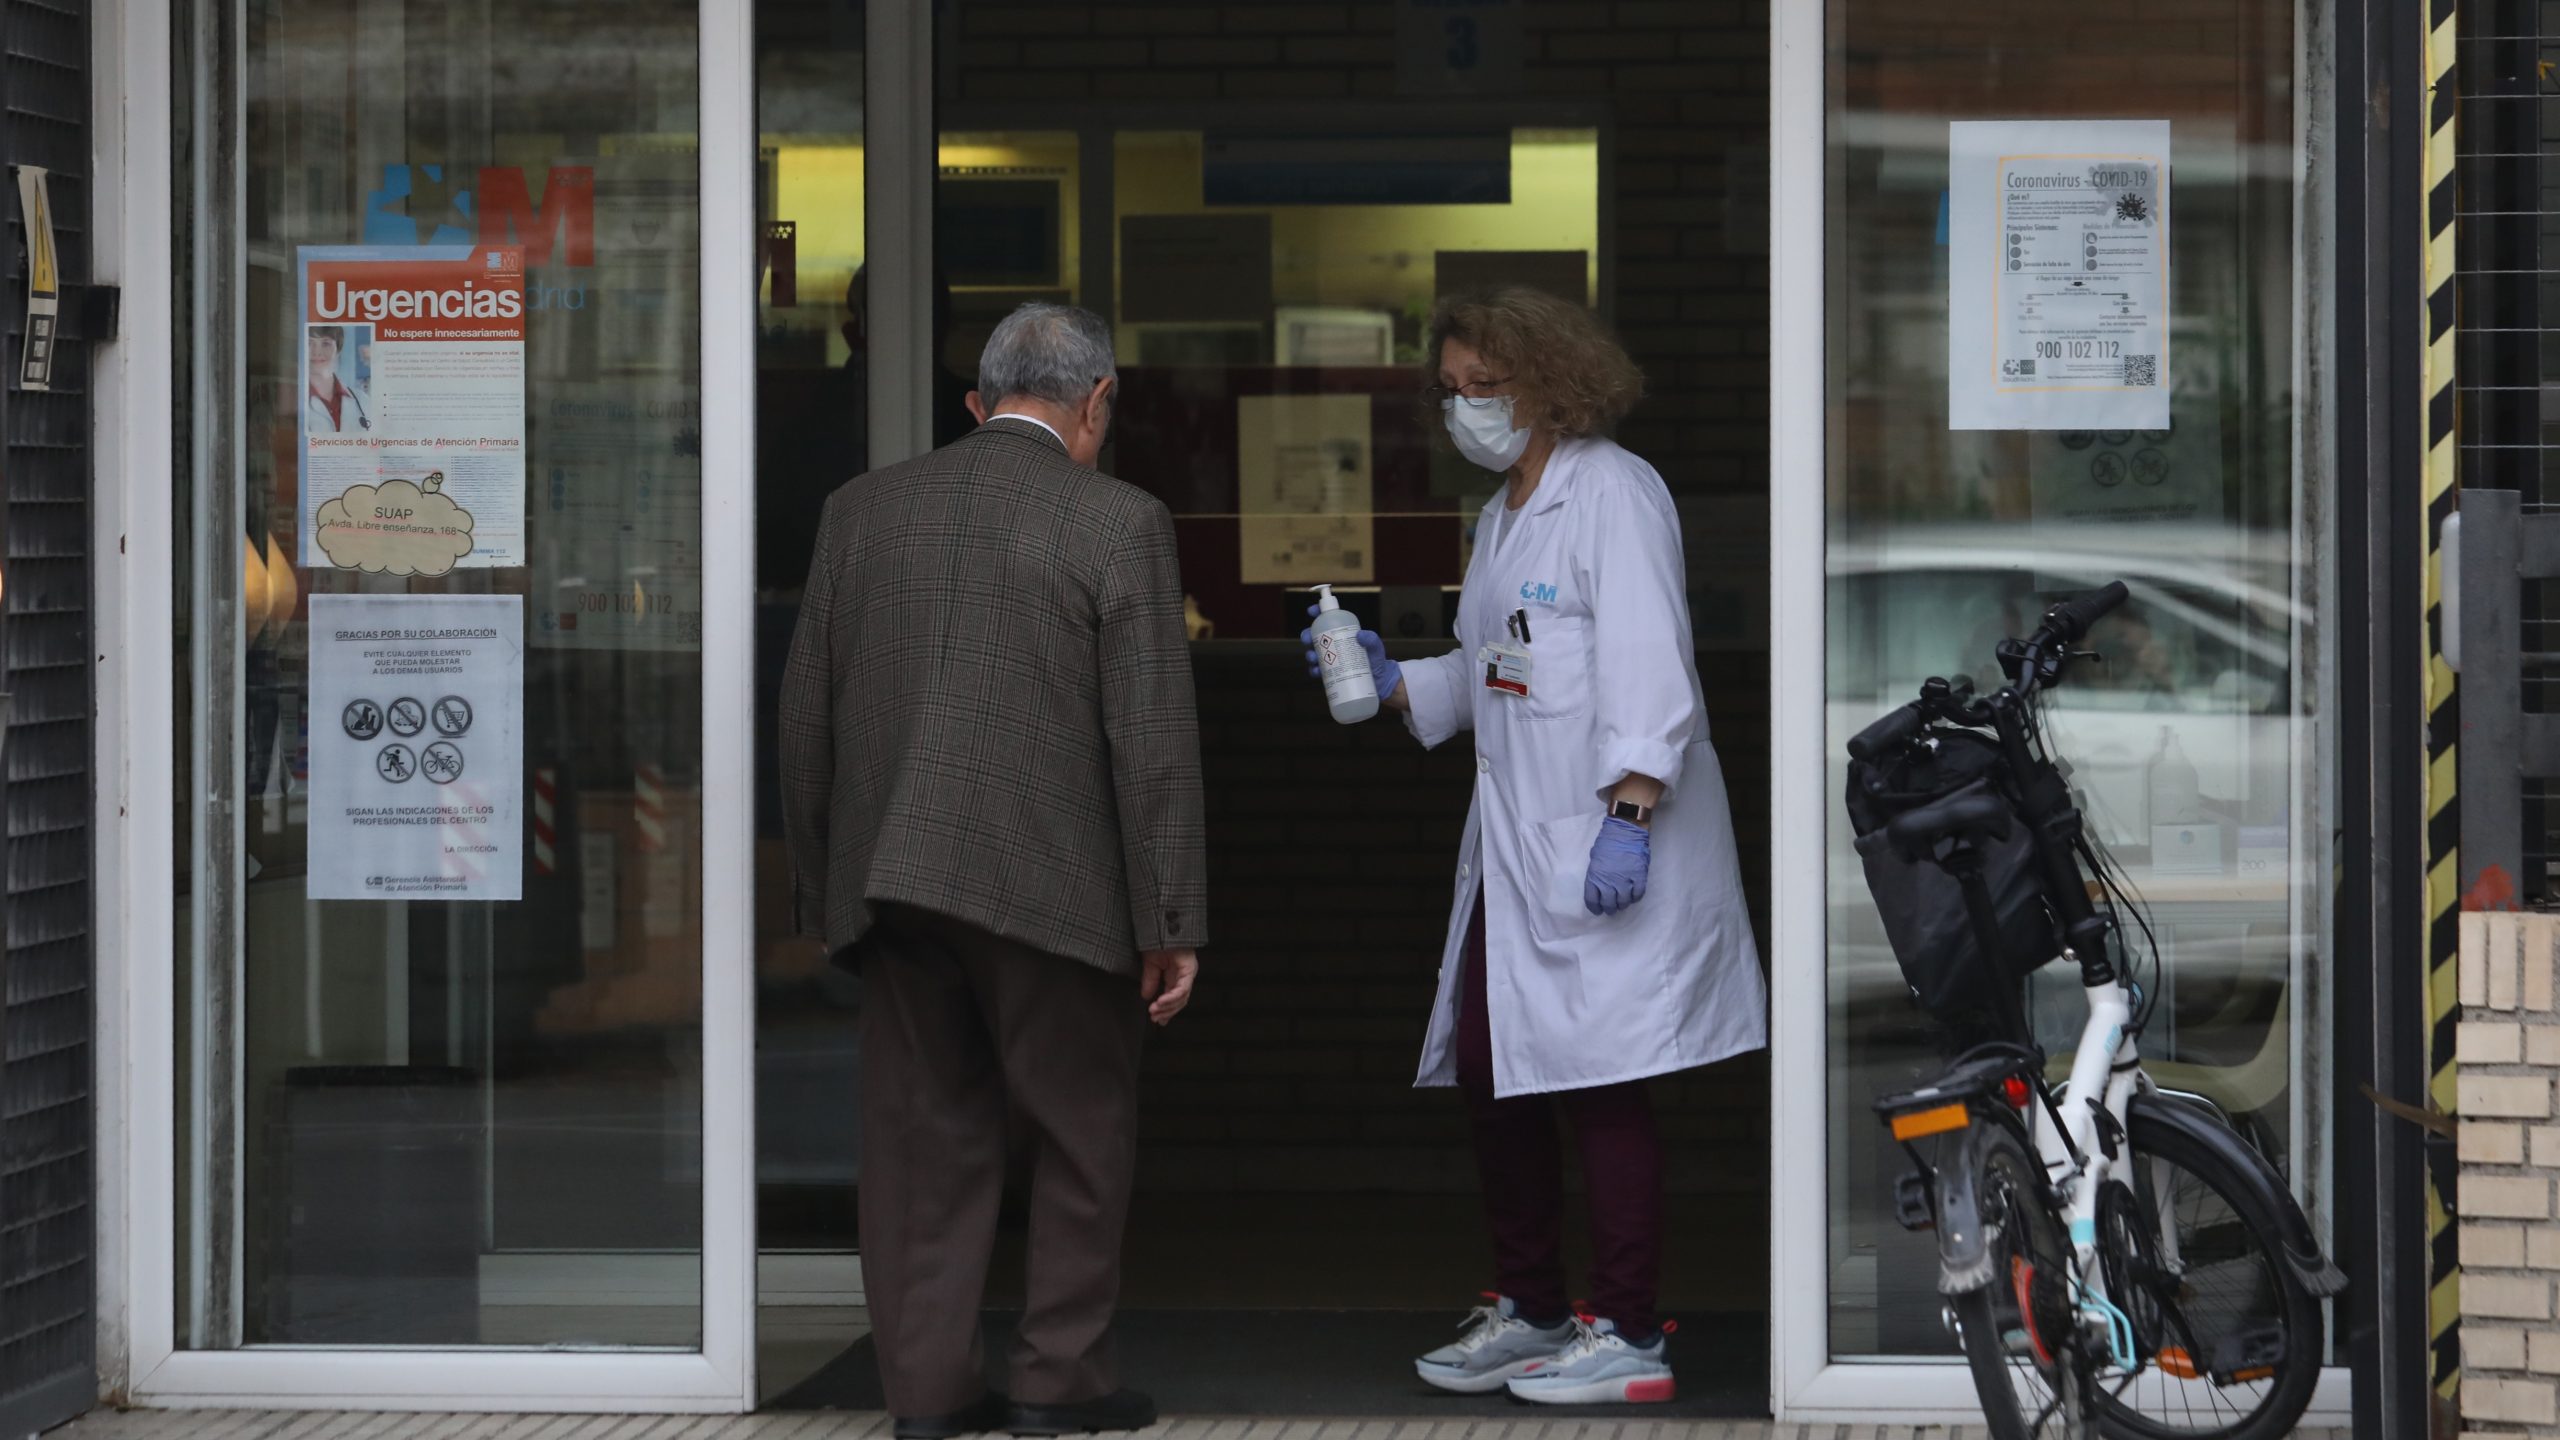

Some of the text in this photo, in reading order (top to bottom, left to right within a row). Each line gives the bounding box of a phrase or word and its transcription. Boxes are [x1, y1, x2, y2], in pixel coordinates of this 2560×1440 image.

[2007, 172, 2080, 188] Coronavirus
[2092, 171, 2148, 187] COVID-19
[315, 280, 522, 321] Urgencias
[384, 328, 520, 340] No espere innecesariamente
[2036, 341, 2120, 358] 900 102 112
[647, 400, 700, 418] COVID-1
[310, 437, 519, 448] Servicios de Urgencias de Atención Primaria
[374, 506, 413, 520] SUAP
[328, 519, 457, 536] Avda. Libre enseñanza, 168
[578, 592, 607, 613] 900
[335, 630, 378, 639] GRACIAS
[381, 630, 400, 638] POR
[404, 629, 417, 638] SU
[387, 650, 429, 658] CUALQUIER
[431, 649, 471, 657] ELEMENTO
[380, 667, 396, 675] LOS
[424, 666, 463, 674] USUARIOS
[346, 806, 494, 816] SIGAN LAS INDICACIONES DE LOS
[353, 816, 487, 825] PROFESIONALES DEL CENTRO
